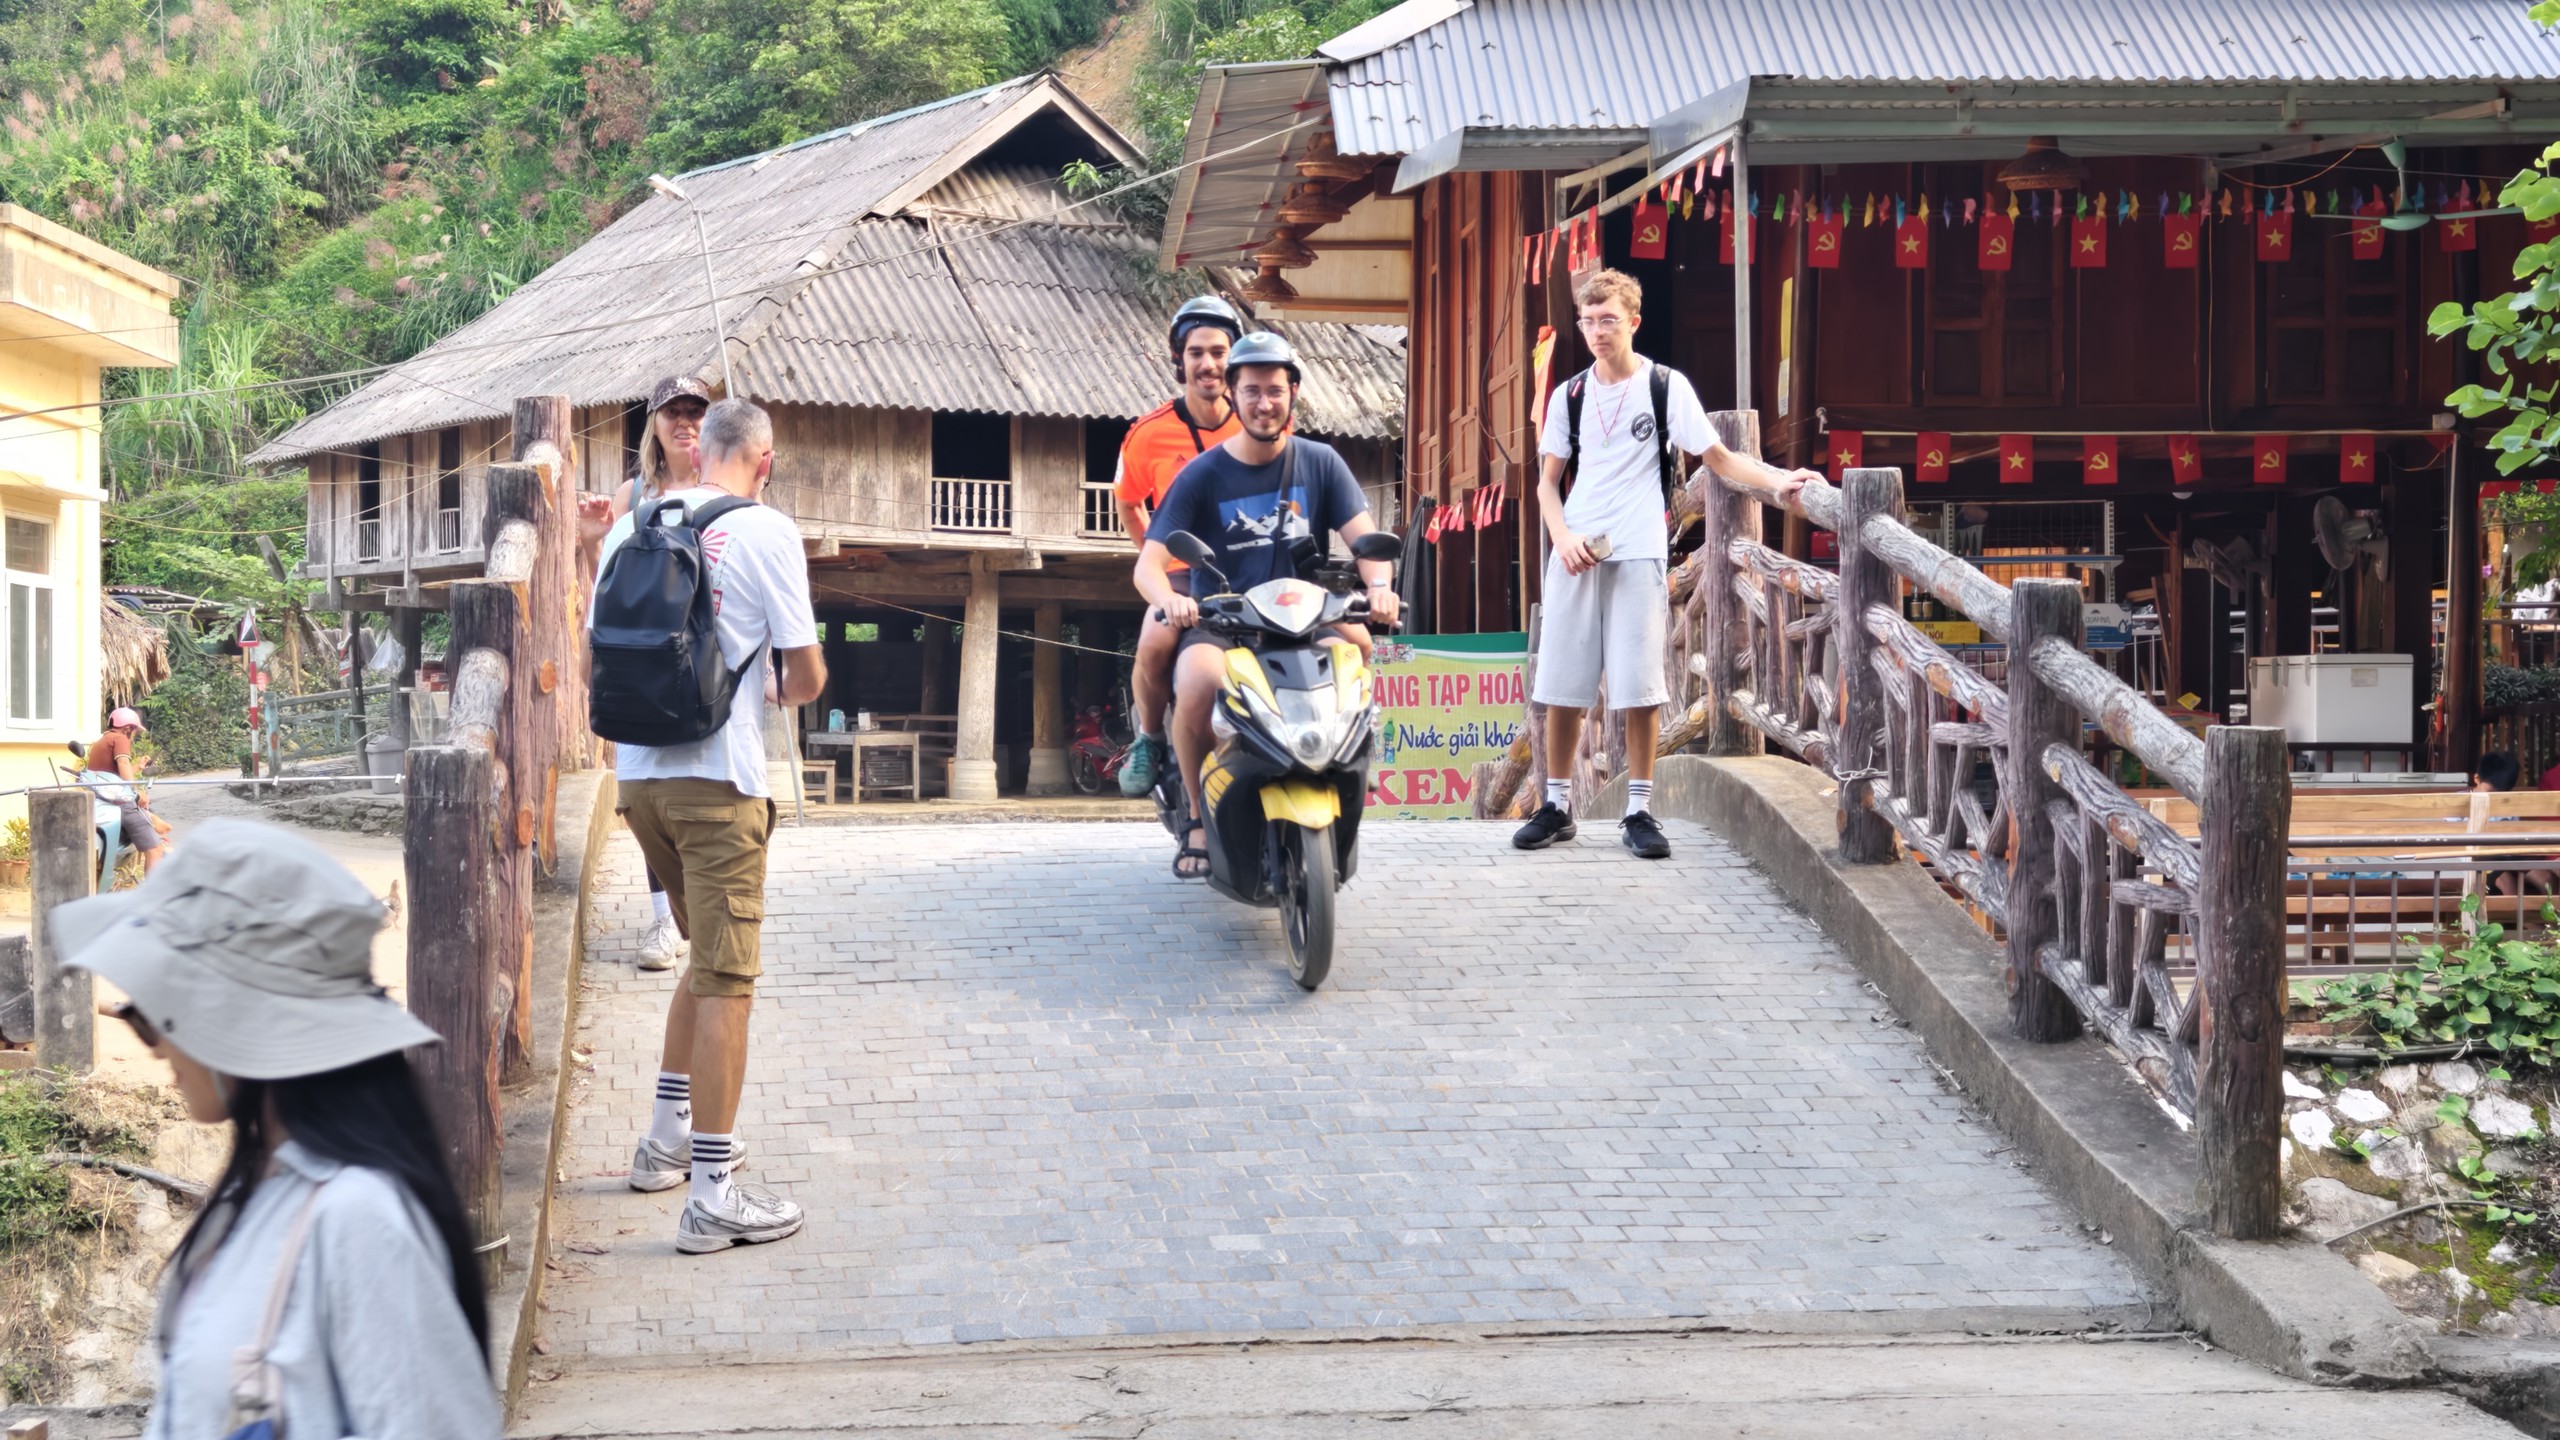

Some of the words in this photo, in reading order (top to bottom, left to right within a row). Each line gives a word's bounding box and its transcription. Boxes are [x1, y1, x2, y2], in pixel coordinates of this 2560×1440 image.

[1427, 673, 1471, 713] TẠP
[1478, 666, 1526, 705] HOÁ
[1396, 723, 1444, 752] Nước
[1449, 722, 1479, 756] giải
